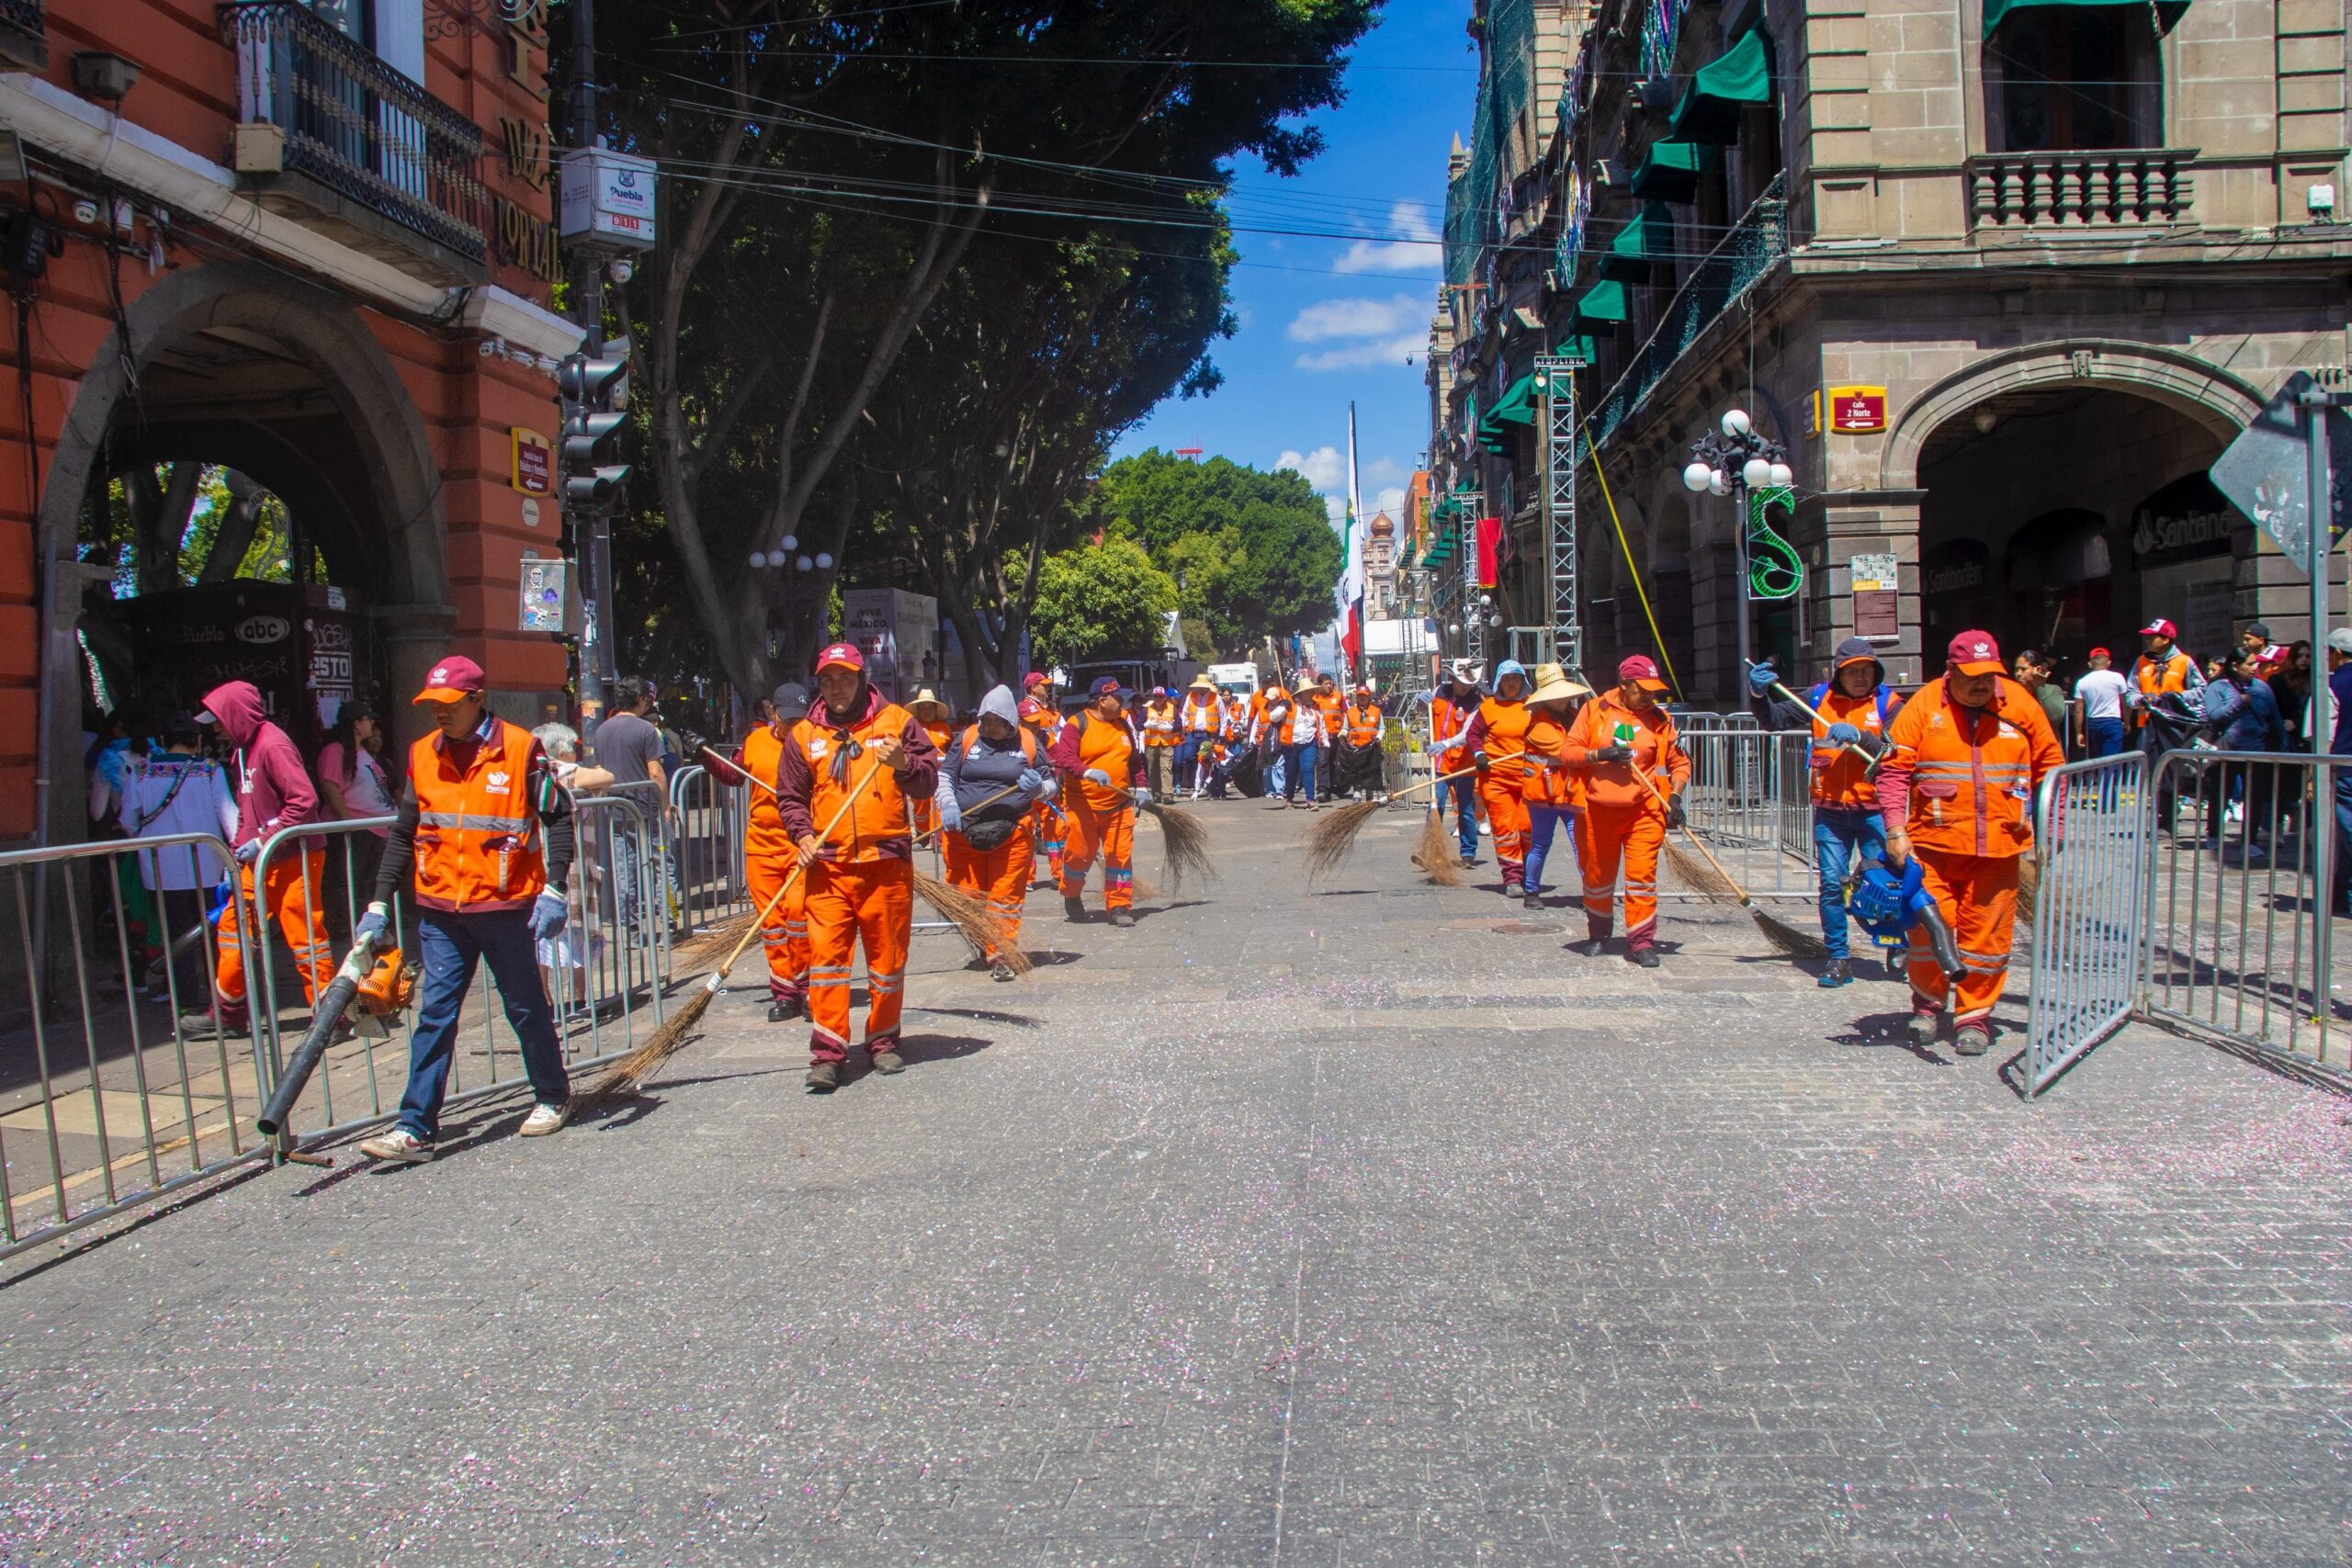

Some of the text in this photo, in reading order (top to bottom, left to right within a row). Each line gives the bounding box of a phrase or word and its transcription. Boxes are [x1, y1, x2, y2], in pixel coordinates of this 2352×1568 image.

[610, 186, 643, 201] Puebla
[614, 218, 639, 230] 911
[496, 197, 564, 284] PORTAL
[244, 621, 279, 639] abc
[859, 637, 882, 645] VIVA
[858, 646, 889, 655] UEBLA!
